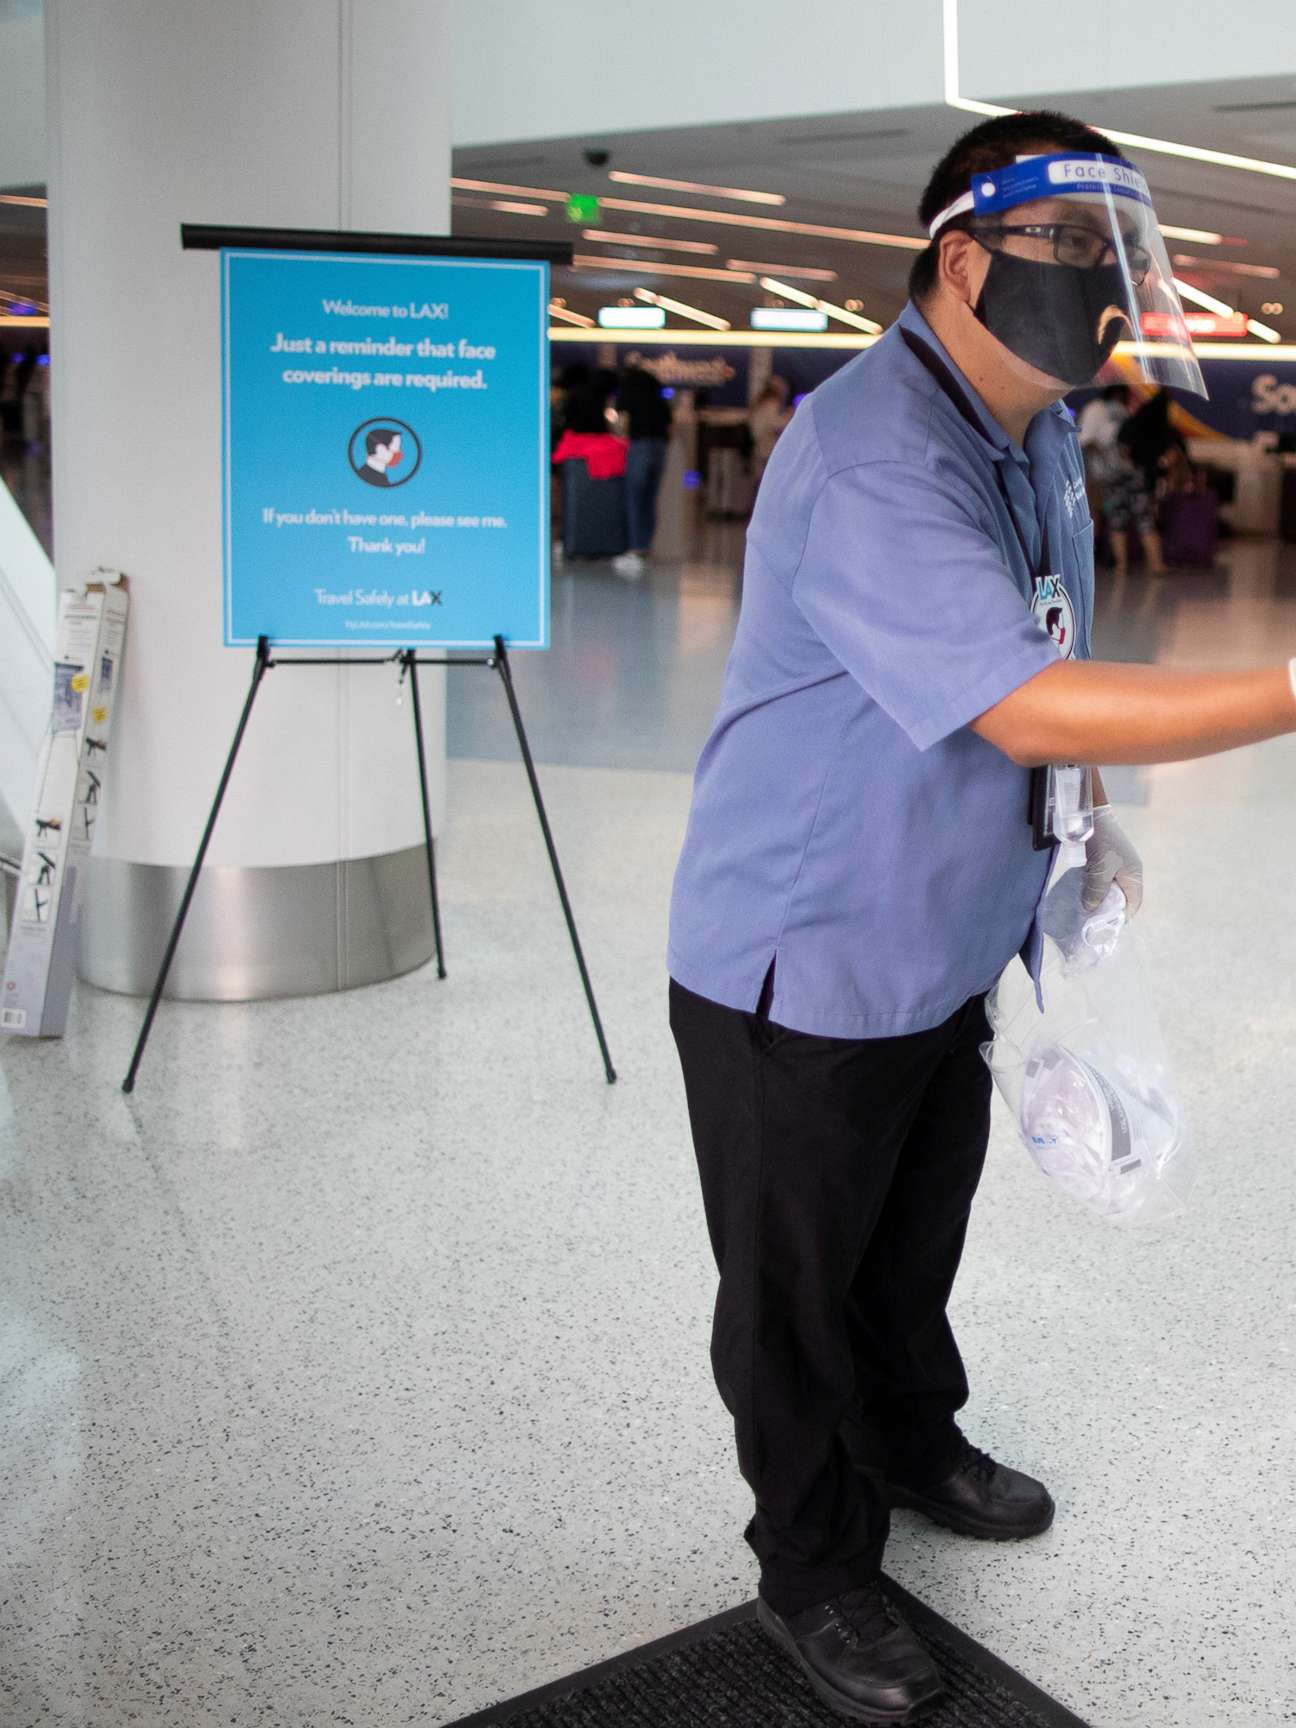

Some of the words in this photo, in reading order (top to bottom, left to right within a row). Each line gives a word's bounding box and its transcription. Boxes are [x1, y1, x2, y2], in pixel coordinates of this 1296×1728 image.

[1063, 162, 1105, 178] Face
[322, 299, 389, 317] Welcome
[393, 303, 407, 318] to
[410, 303, 449, 319] LAX!
[270, 332, 313, 353] Just
[315, 341, 327, 354] a
[330, 336, 414, 357] reminder
[417, 338, 455, 358] that
[458, 339, 496, 359] face
[282, 367, 370, 390] coverings
[373, 373, 402, 387] are
[406, 370, 487, 392] required.
[262, 508, 274, 524] If
[276, 511, 303, 528] you
[305, 508, 340, 525] don't
[343, 510, 377, 526] have
[411, 511, 454, 529] please
[457, 516, 480, 528] see
[482, 516, 507, 529] me.
[348, 536, 392, 553] Thank
[395, 538, 426, 556] you!
[1037, 574, 1061, 600] LAX
[314, 588, 353, 605] Travel
[355, 589, 395, 608] Safely
[396, 592, 408, 606] at
[411, 590, 442, 606] LAX
